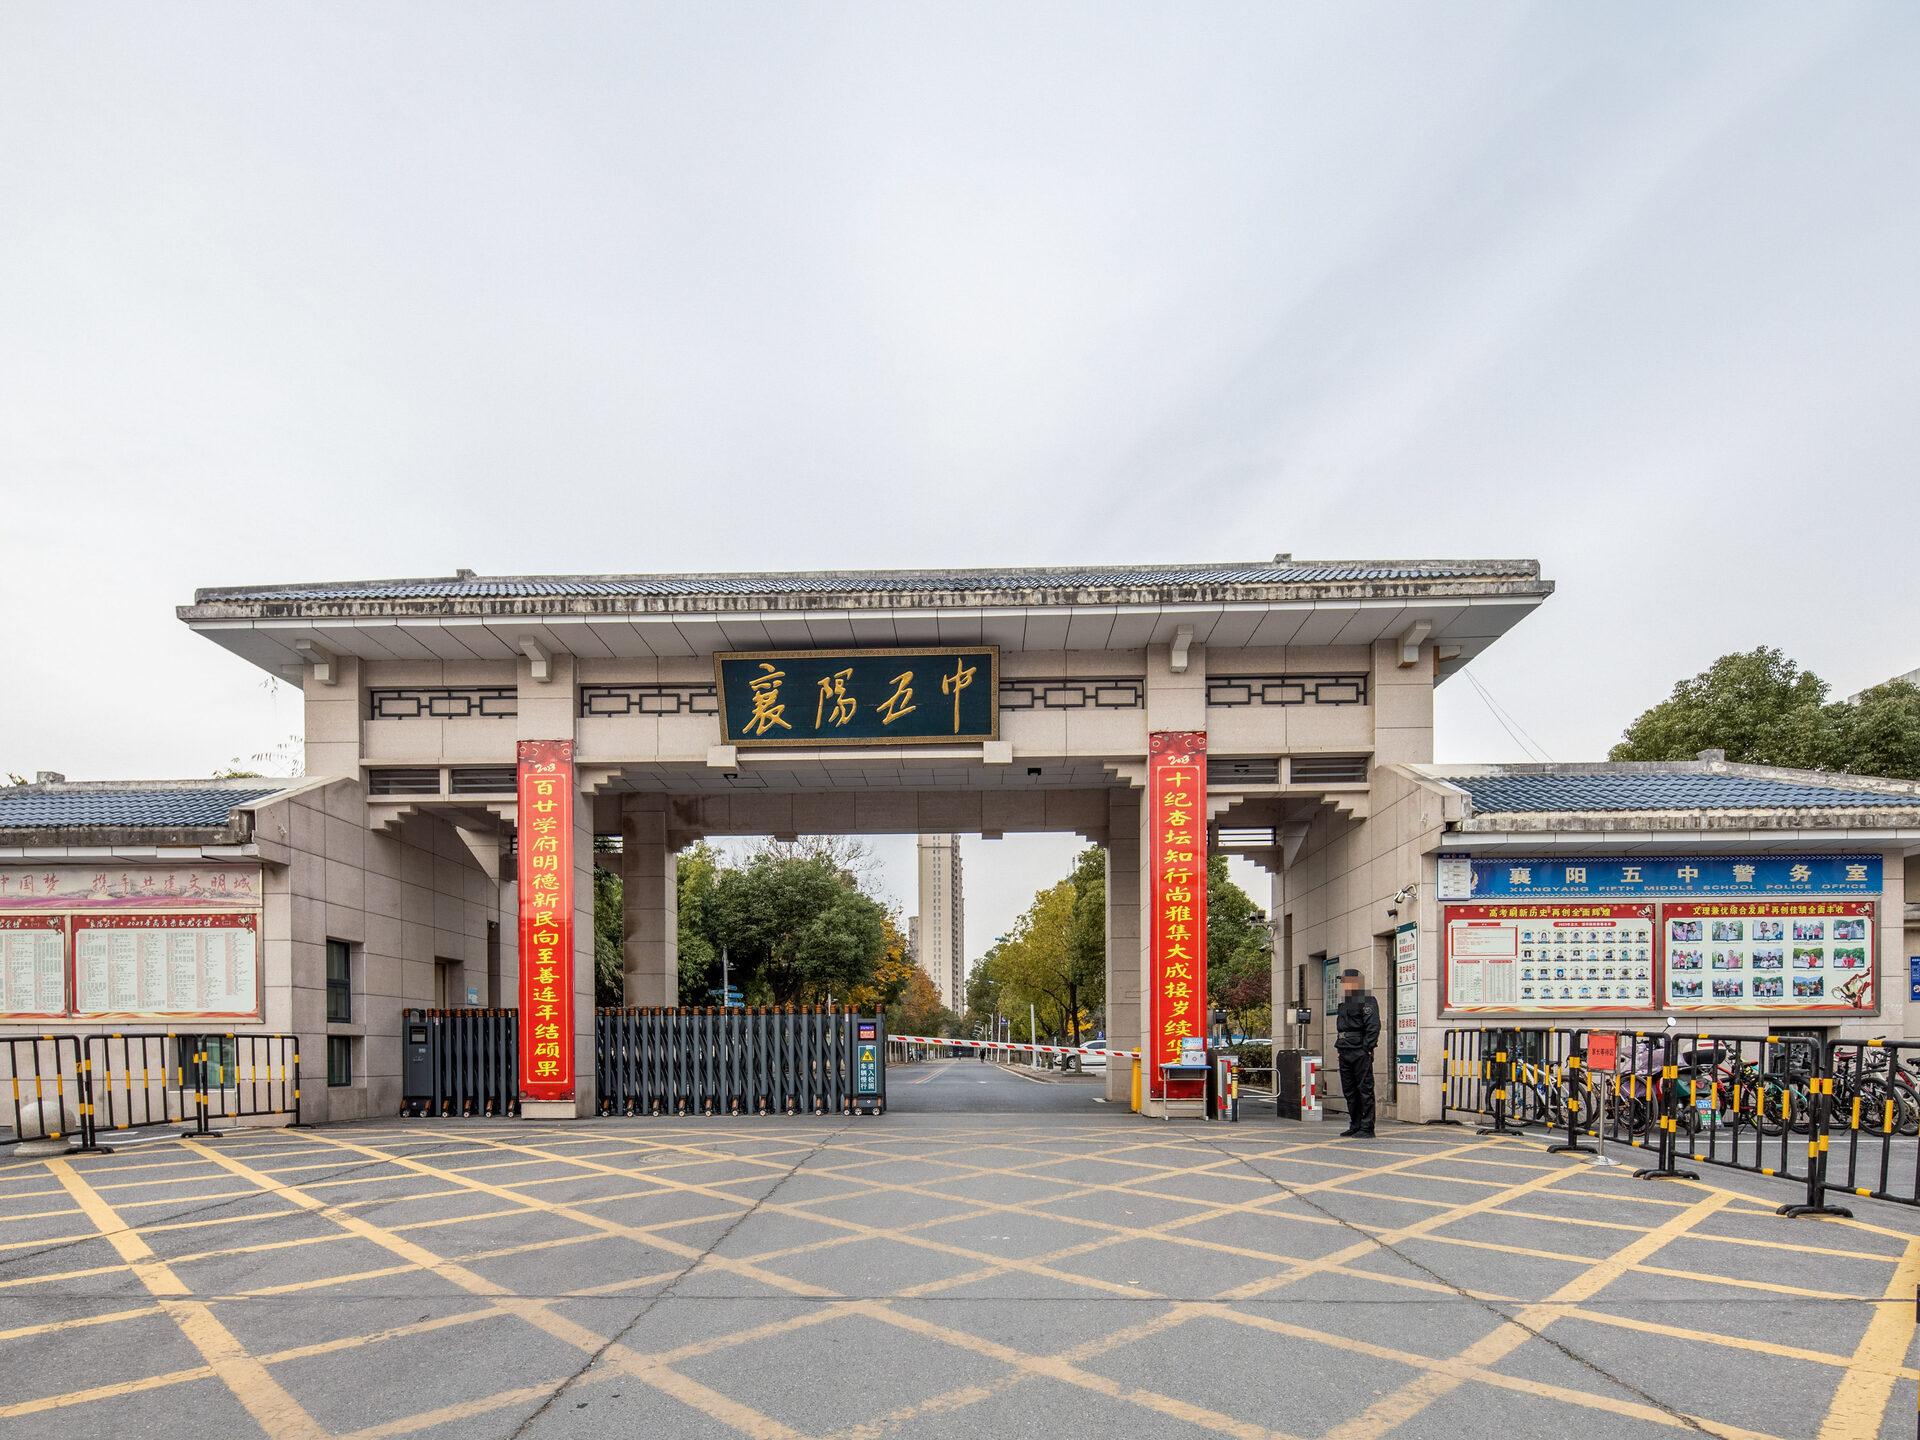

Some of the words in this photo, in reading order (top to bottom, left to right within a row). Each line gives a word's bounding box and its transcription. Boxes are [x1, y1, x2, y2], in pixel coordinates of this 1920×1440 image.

[532, 779, 560, 1077] 百廿学府明德新民向至善连年结硕果
[1164, 771, 1193, 1065] 十纪杏坛知行尚雅集大成接岁续华
[1509, 863, 1868, 885] 襄阳五中警务室
